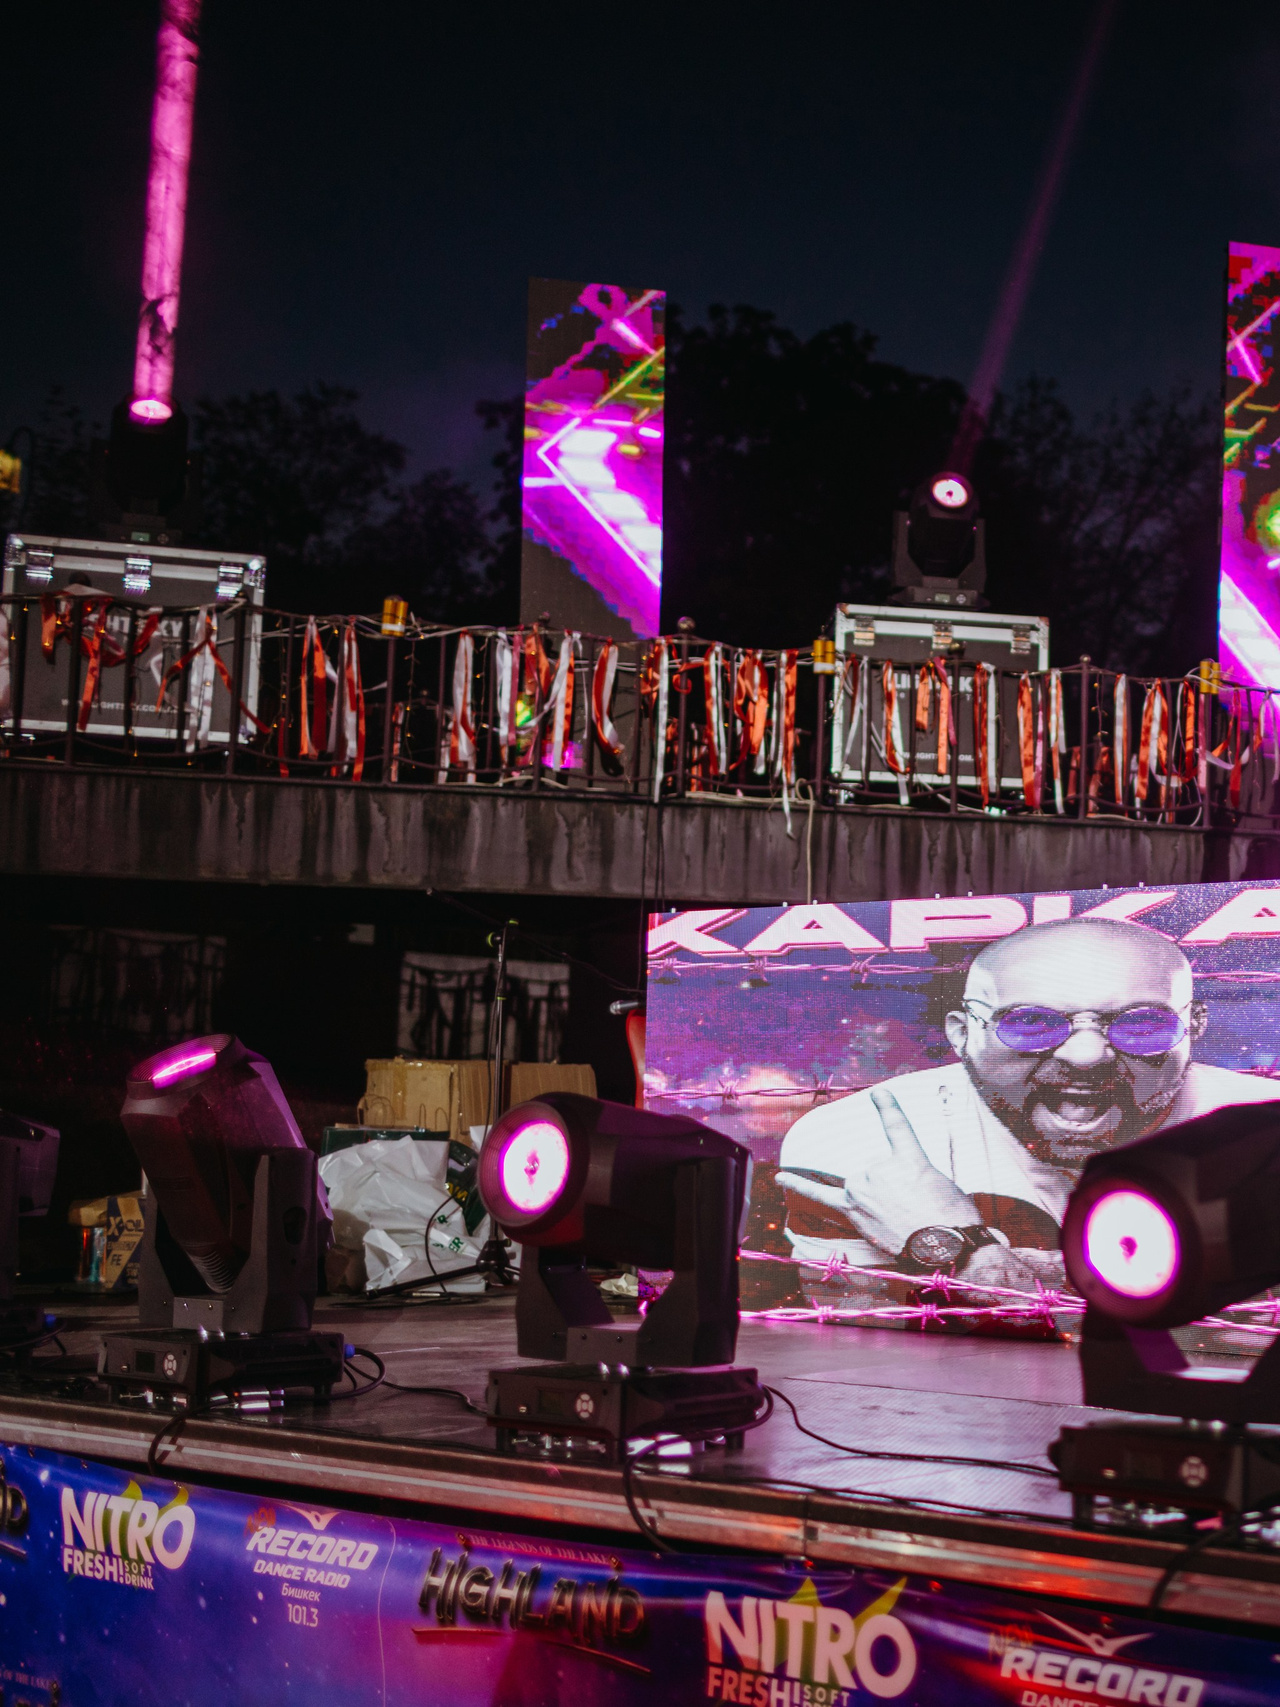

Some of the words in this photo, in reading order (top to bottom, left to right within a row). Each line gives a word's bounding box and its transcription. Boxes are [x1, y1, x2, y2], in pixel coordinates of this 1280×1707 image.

[61, 1487, 196, 1570] NITRO
[246, 1526, 379, 1571] RECORD
[63, 1547, 124, 1584] FRESH!
[124, 1560, 152, 1577] SOFT
[125, 1574, 155, 1590] DRINK
[253, 1559, 304, 1581] DANCE
[304, 1567, 351, 1589] RADIO
[281, 1582, 321, 1602] Бишкек
[418, 1547, 645, 1643] HIGHLAND
[287, 1602, 319, 1628] 101.3
[705, 1590, 917, 1699] NITRO
[1000, 1648, 1204, 1707] RECORD
[803, 1684, 851, 1707] SOFT
